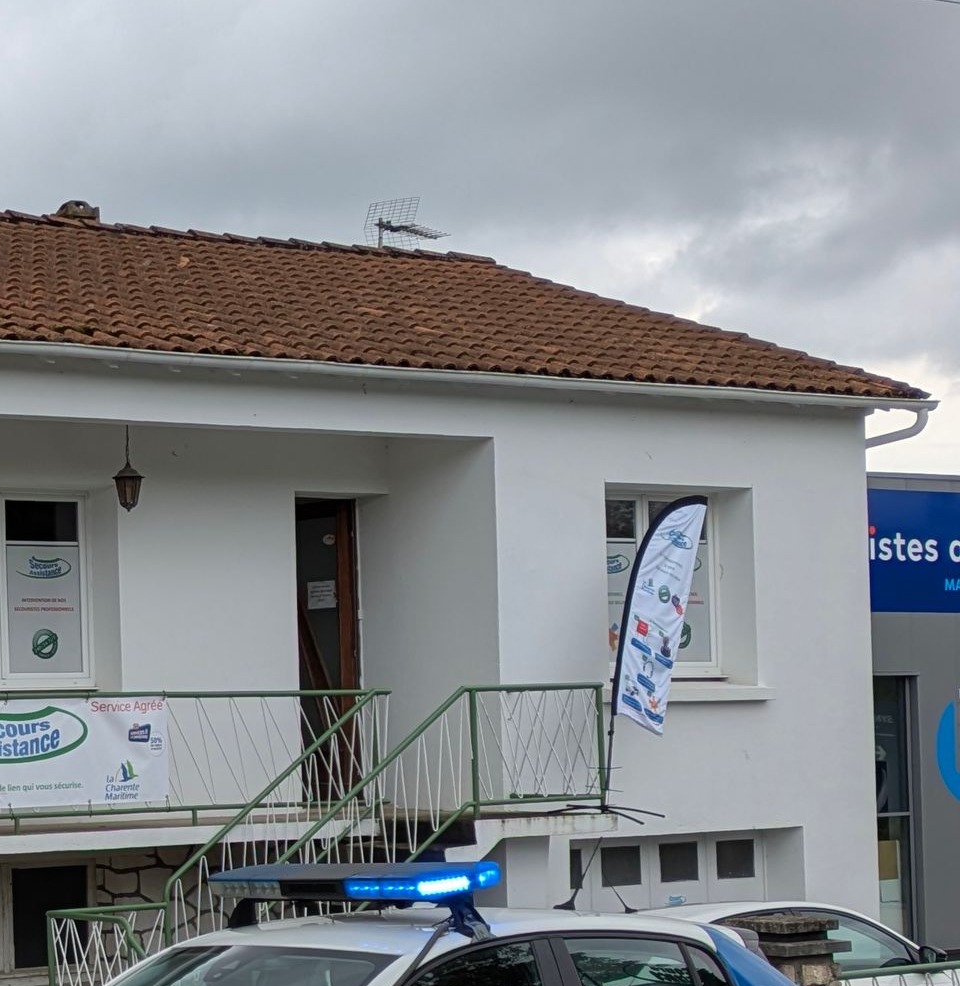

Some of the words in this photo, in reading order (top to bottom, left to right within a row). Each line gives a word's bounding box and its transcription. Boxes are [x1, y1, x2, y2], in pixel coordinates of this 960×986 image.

[28, 558, 58, 569] Secours
[91, 701, 131, 712] Service
[134, 699, 163, 714] Agréé
[22, 783, 34, 793] qui
[106, 784, 140, 792] Charente
[105, 792, 139, 801] Maritime
